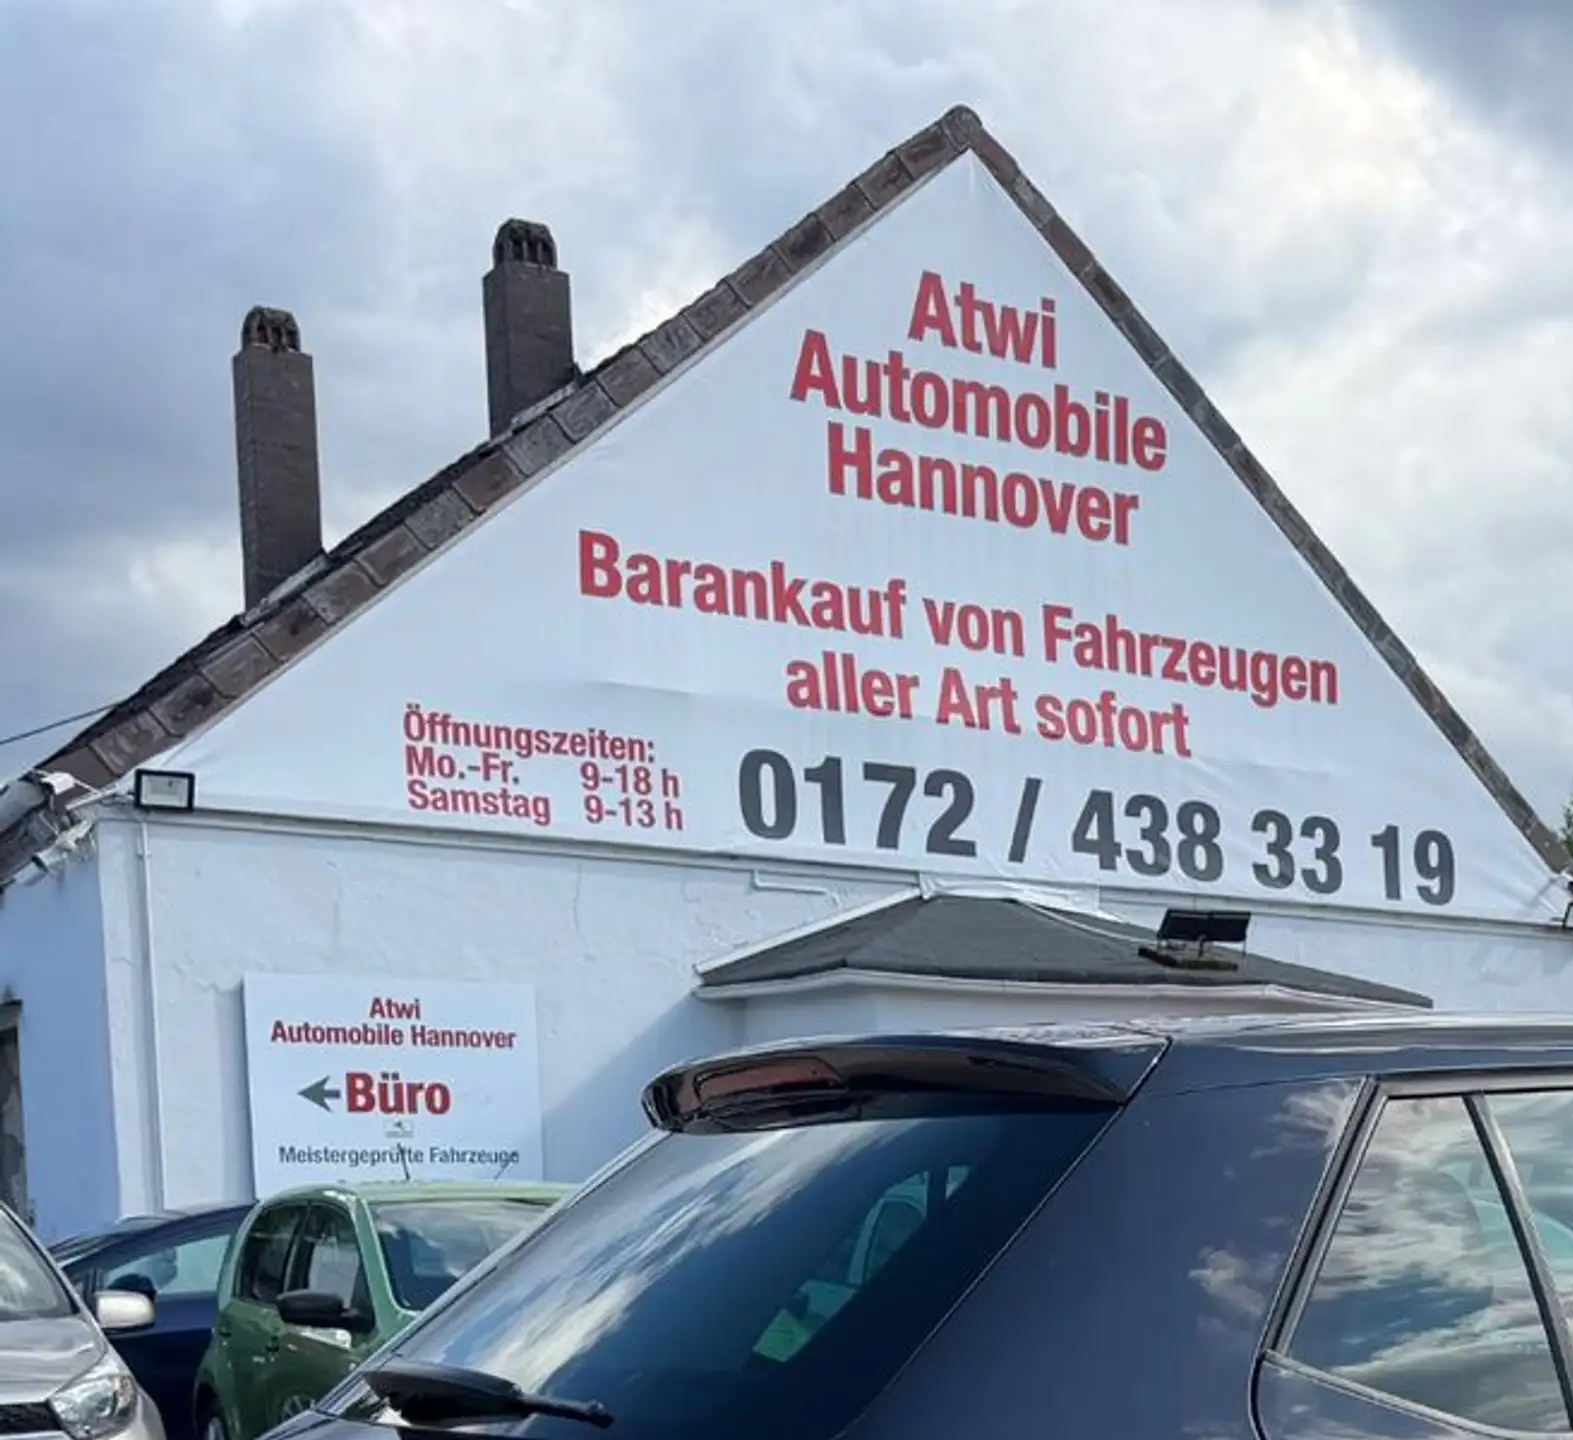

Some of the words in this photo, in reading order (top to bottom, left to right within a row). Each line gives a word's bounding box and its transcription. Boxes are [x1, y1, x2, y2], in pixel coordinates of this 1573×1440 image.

[907, 270, 1056, 369] Atwi
[790, 329, 1168, 471] Automobile
[827, 420, 1140, 546] Hannover
[579, 529, 907, 639] Barankauf
[923, 597, 1025, 657] von
[1042, 603, 1338, 708] Fahrzeugen
[403, 702, 655, 763] Öffnungszeiten:
[786, 650, 920, 719] aller
[936, 667, 1021, 734] Art
[1035, 691, 1191, 758] sofort
[405, 746, 520, 785] Mo.-Fr.
[580, 761, 652, 795] 9-18
[661, 768, 680, 798] h
[407, 779, 551, 827] Samstag
[583, 795, 656, 829] 9-13
[665, 802, 683, 830] h
[739, 749, 977, 858] 0172
[1008, 777, 1042, 864] /
[1071, 789, 1224, 882] 438
[1251, 809, 1343, 894] 33
[1371, 825, 1456, 906] 19
[271, 1020, 404, 1046] Automobile
[411, 1024, 517, 1049] Hannover
[369, 997, 421, 1020] Atwi
[345, 1072, 451, 1115] Büro
[430, 1146, 520, 1167] Fahrzeuge
